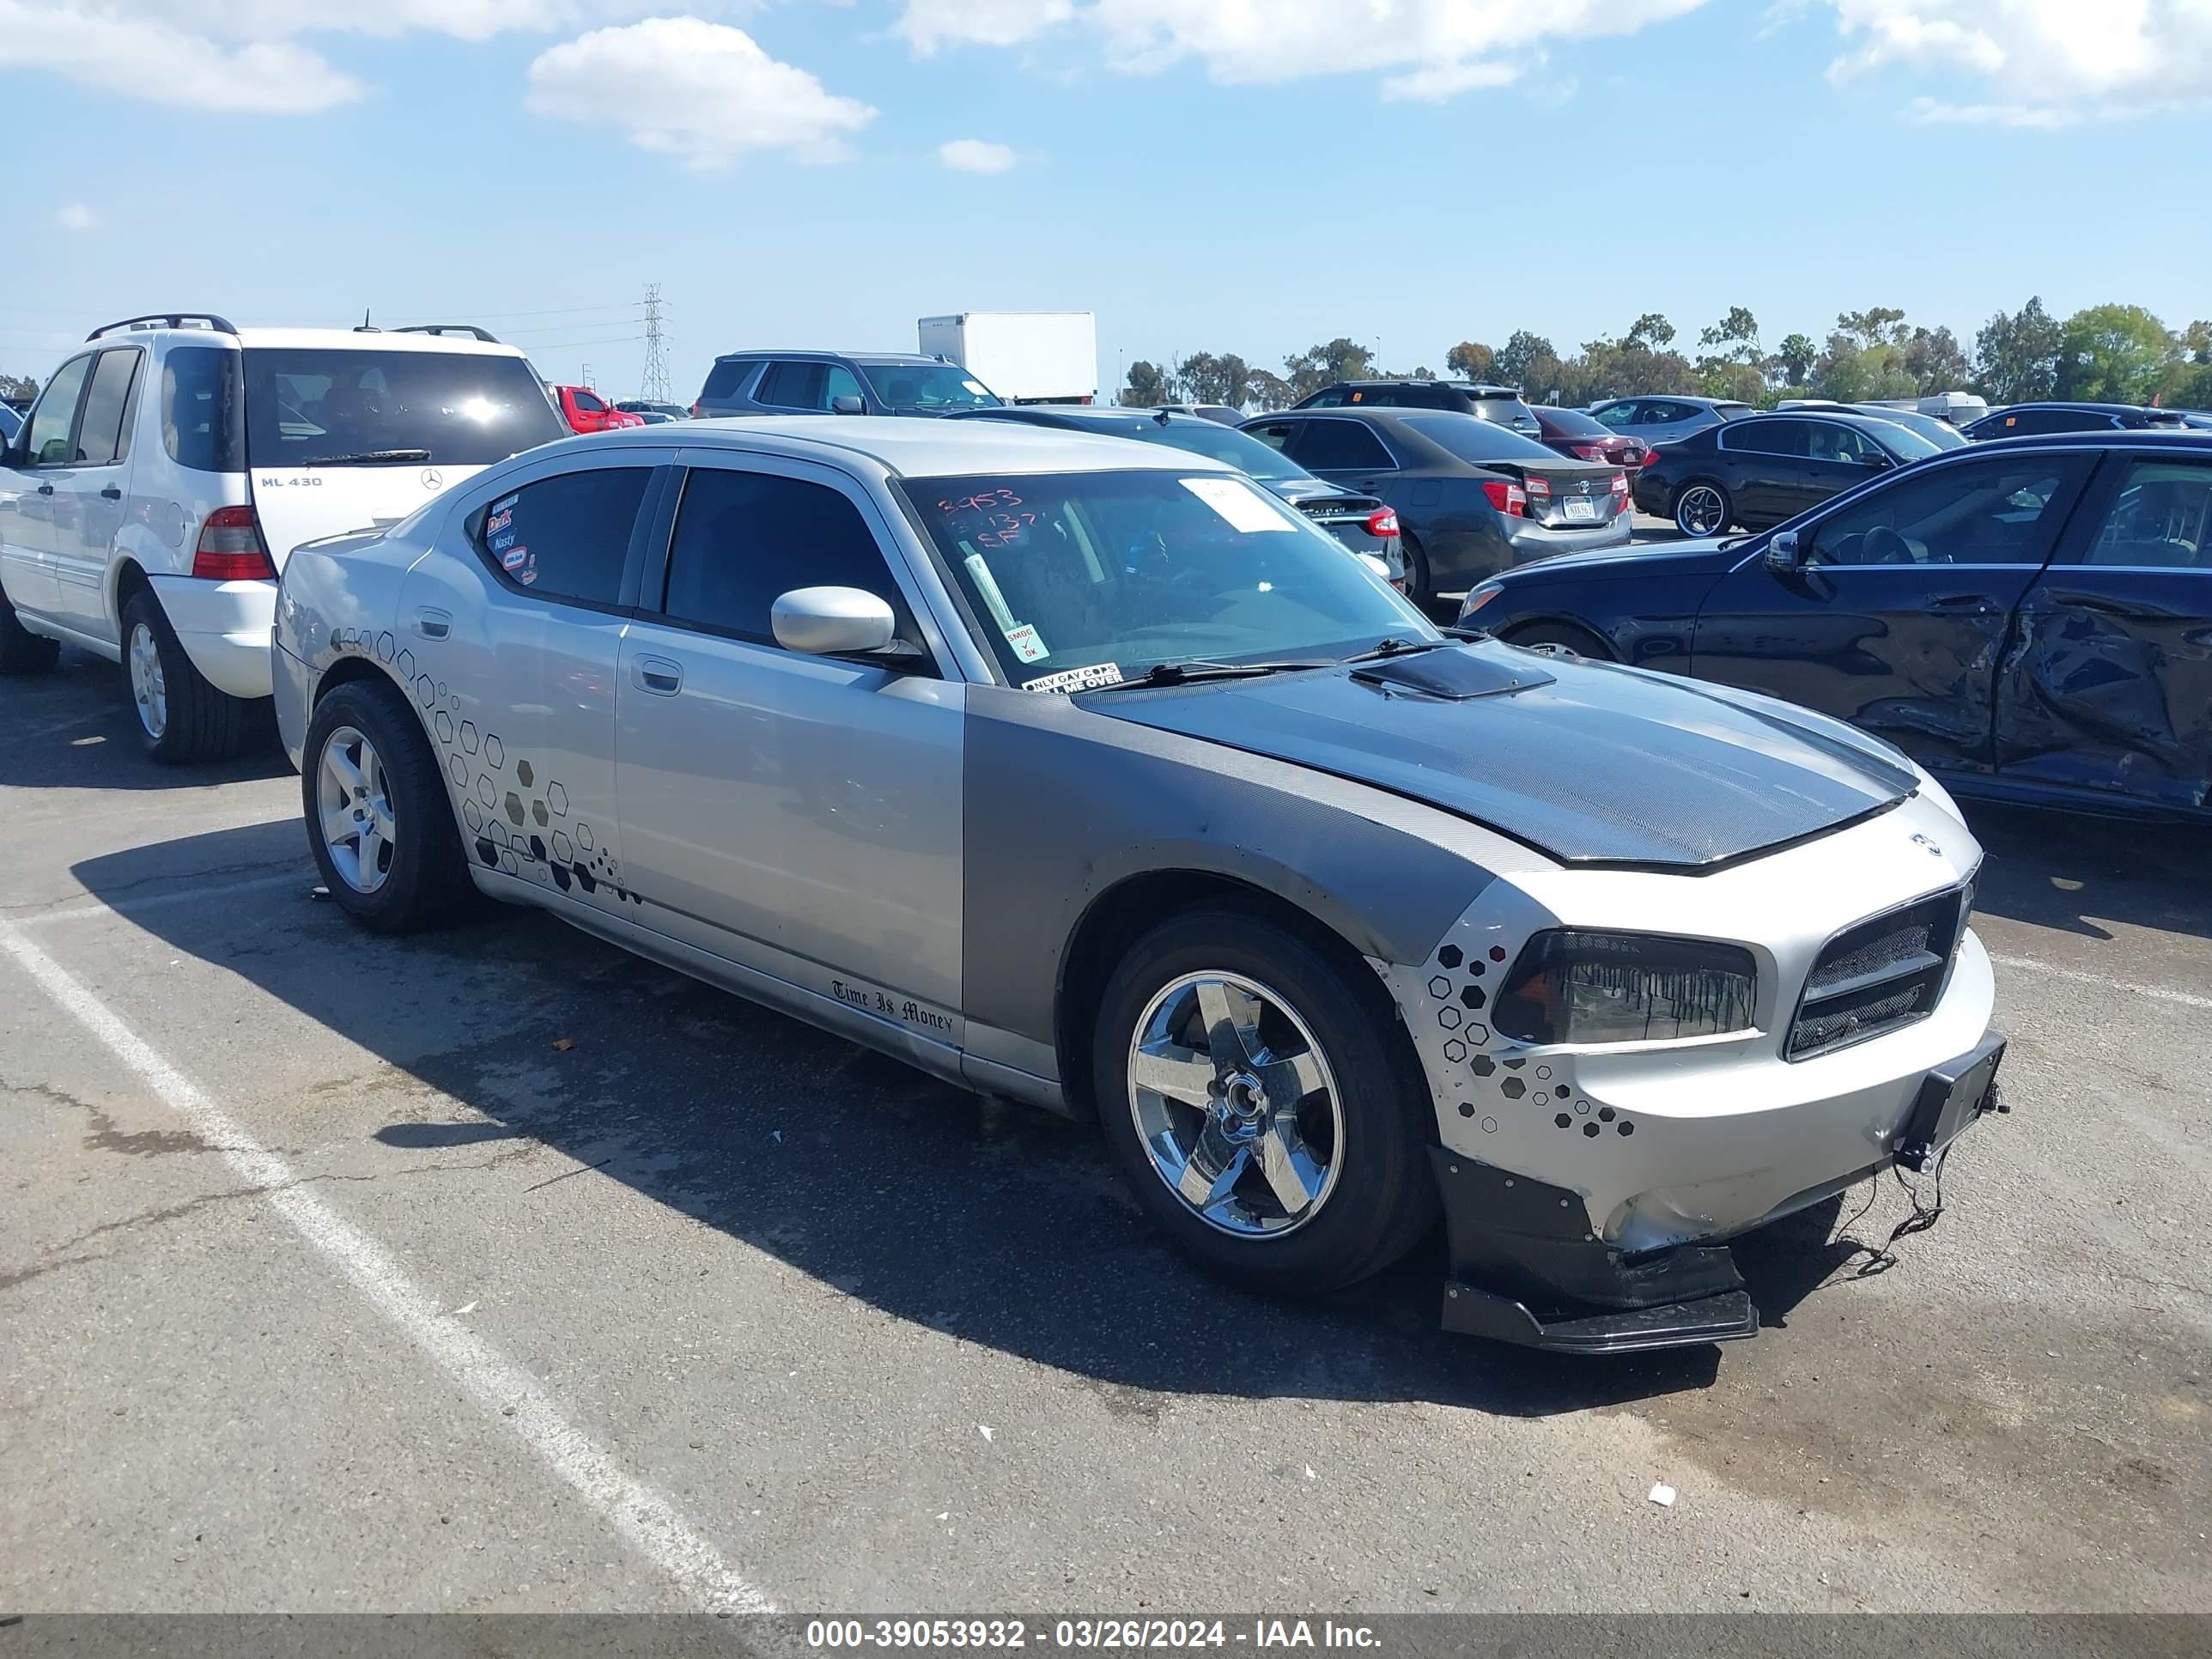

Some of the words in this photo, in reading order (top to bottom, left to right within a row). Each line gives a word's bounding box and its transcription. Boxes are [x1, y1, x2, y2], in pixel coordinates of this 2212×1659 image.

[262, 477, 284, 487] ML
[289, 477, 322, 486] 430
[495, 534, 515, 550] Nasty
[1007, 629, 1033, 642] SMOG
[1024, 647, 1038, 658] OK
[1058, 672, 1081, 683] GAY
[1084, 665, 1116, 678] COPS
[1063, 681, 1086, 694] ME
[1085, 674, 1125, 689] OVER
[831, 980, 868, 1006] Time
[875, 992, 895, 1015] Is
[902, 1001, 953, 1033] Money
